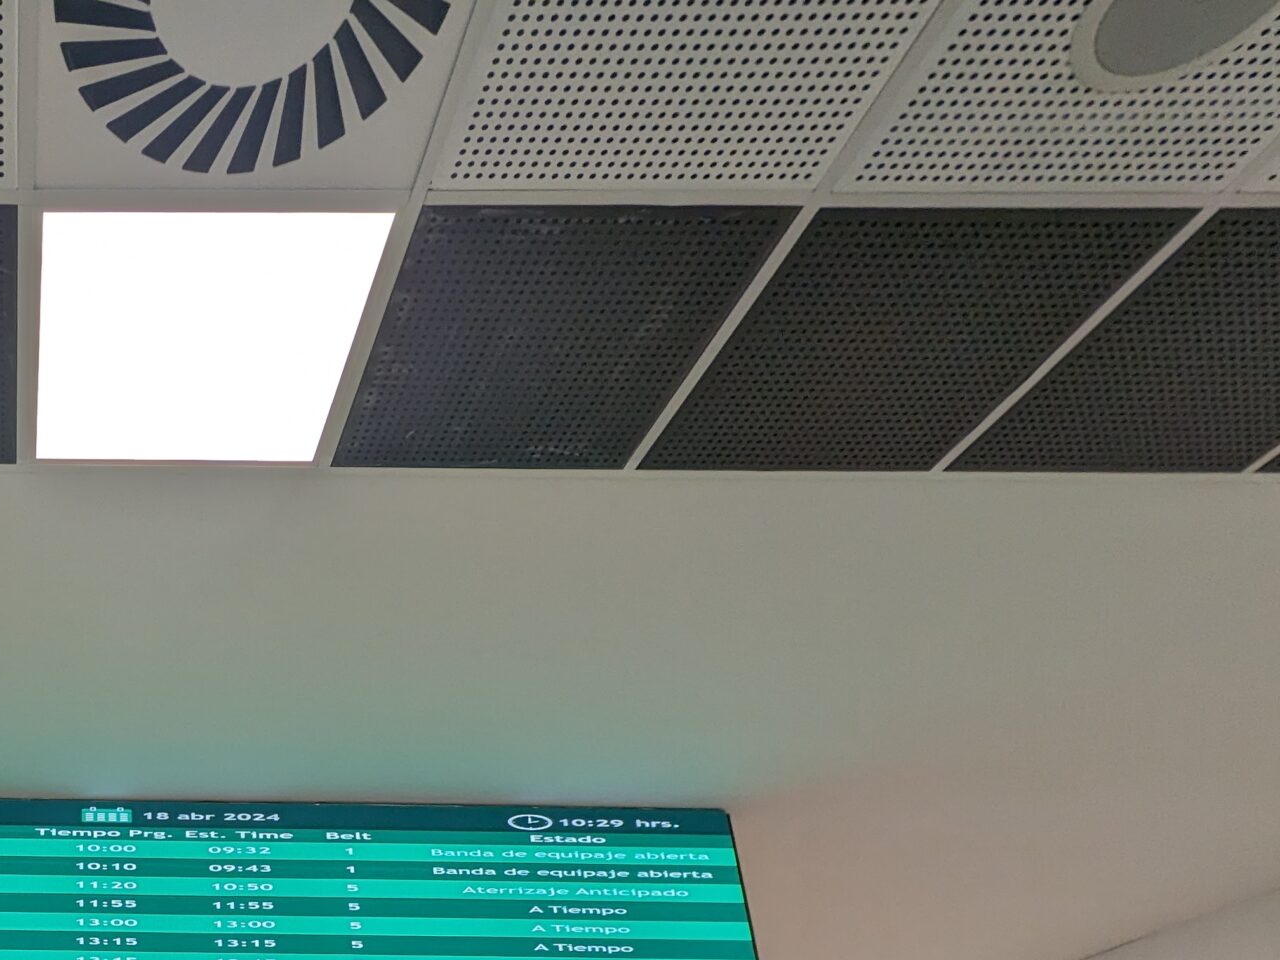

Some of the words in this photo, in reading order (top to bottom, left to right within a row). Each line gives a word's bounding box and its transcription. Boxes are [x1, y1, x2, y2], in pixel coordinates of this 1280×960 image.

[144, 811, 169, 821] 18
[177, 811, 215, 821] abr
[224, 812, 280, 822] 2024
[559, 818, 624, 828] 10:29
[636, 818, 679, 829] hrs.
[35, 827, 120, 839] Tiempo
[129, 829, 172, 840] Prg.
[185, 829, 225, 839] Est.
[235, 830, 293, 840] Time
[326, 831, 371, 841] Belt
[530, 834, 606, 844] Estado
[76, 844, 136, 853] 10:00
[208, 846, 270, 855] 09:32
[431, 848, 494, 858] Banda
[502, 849, 527, 858] de
[535, 850, 626, 861] equipaje
[635, 851, 709, 861] abierta
[76, 861, 136, 871] 10:10
[209, 863, 271, 873] 09:43
[433, 866, 496, 876] Banda
[504, 867, 530, 876] de
[537, 868, 629, 880] equipaje
[637, 869, 713, 879] abierta
[76, 880, 137, 890] 11:20
[212, 882, 273, 891] 10:50
[463, 885, 568, 897] Aterrizaje
[576, 887, 688, 898] Anticipado
[76, 898, 136, 909] 11:55
[213, 901, 274, 910] 11:55
[529, 905, 543, 914] A
[548, 905, 627, 917] Tiempo
[76, 917, 137, 927] 13:00
[214, 920, 275, 929] 13:00
[532, 924, 546, 933] A
[552, 924, 630, 935] Tiempo
[76, 936, 137, 946] 13:15
[214, 938, 276, 948] 13:15
[534, 943, 549, 952] A
[553, 943, 634, 955] Tiempo
